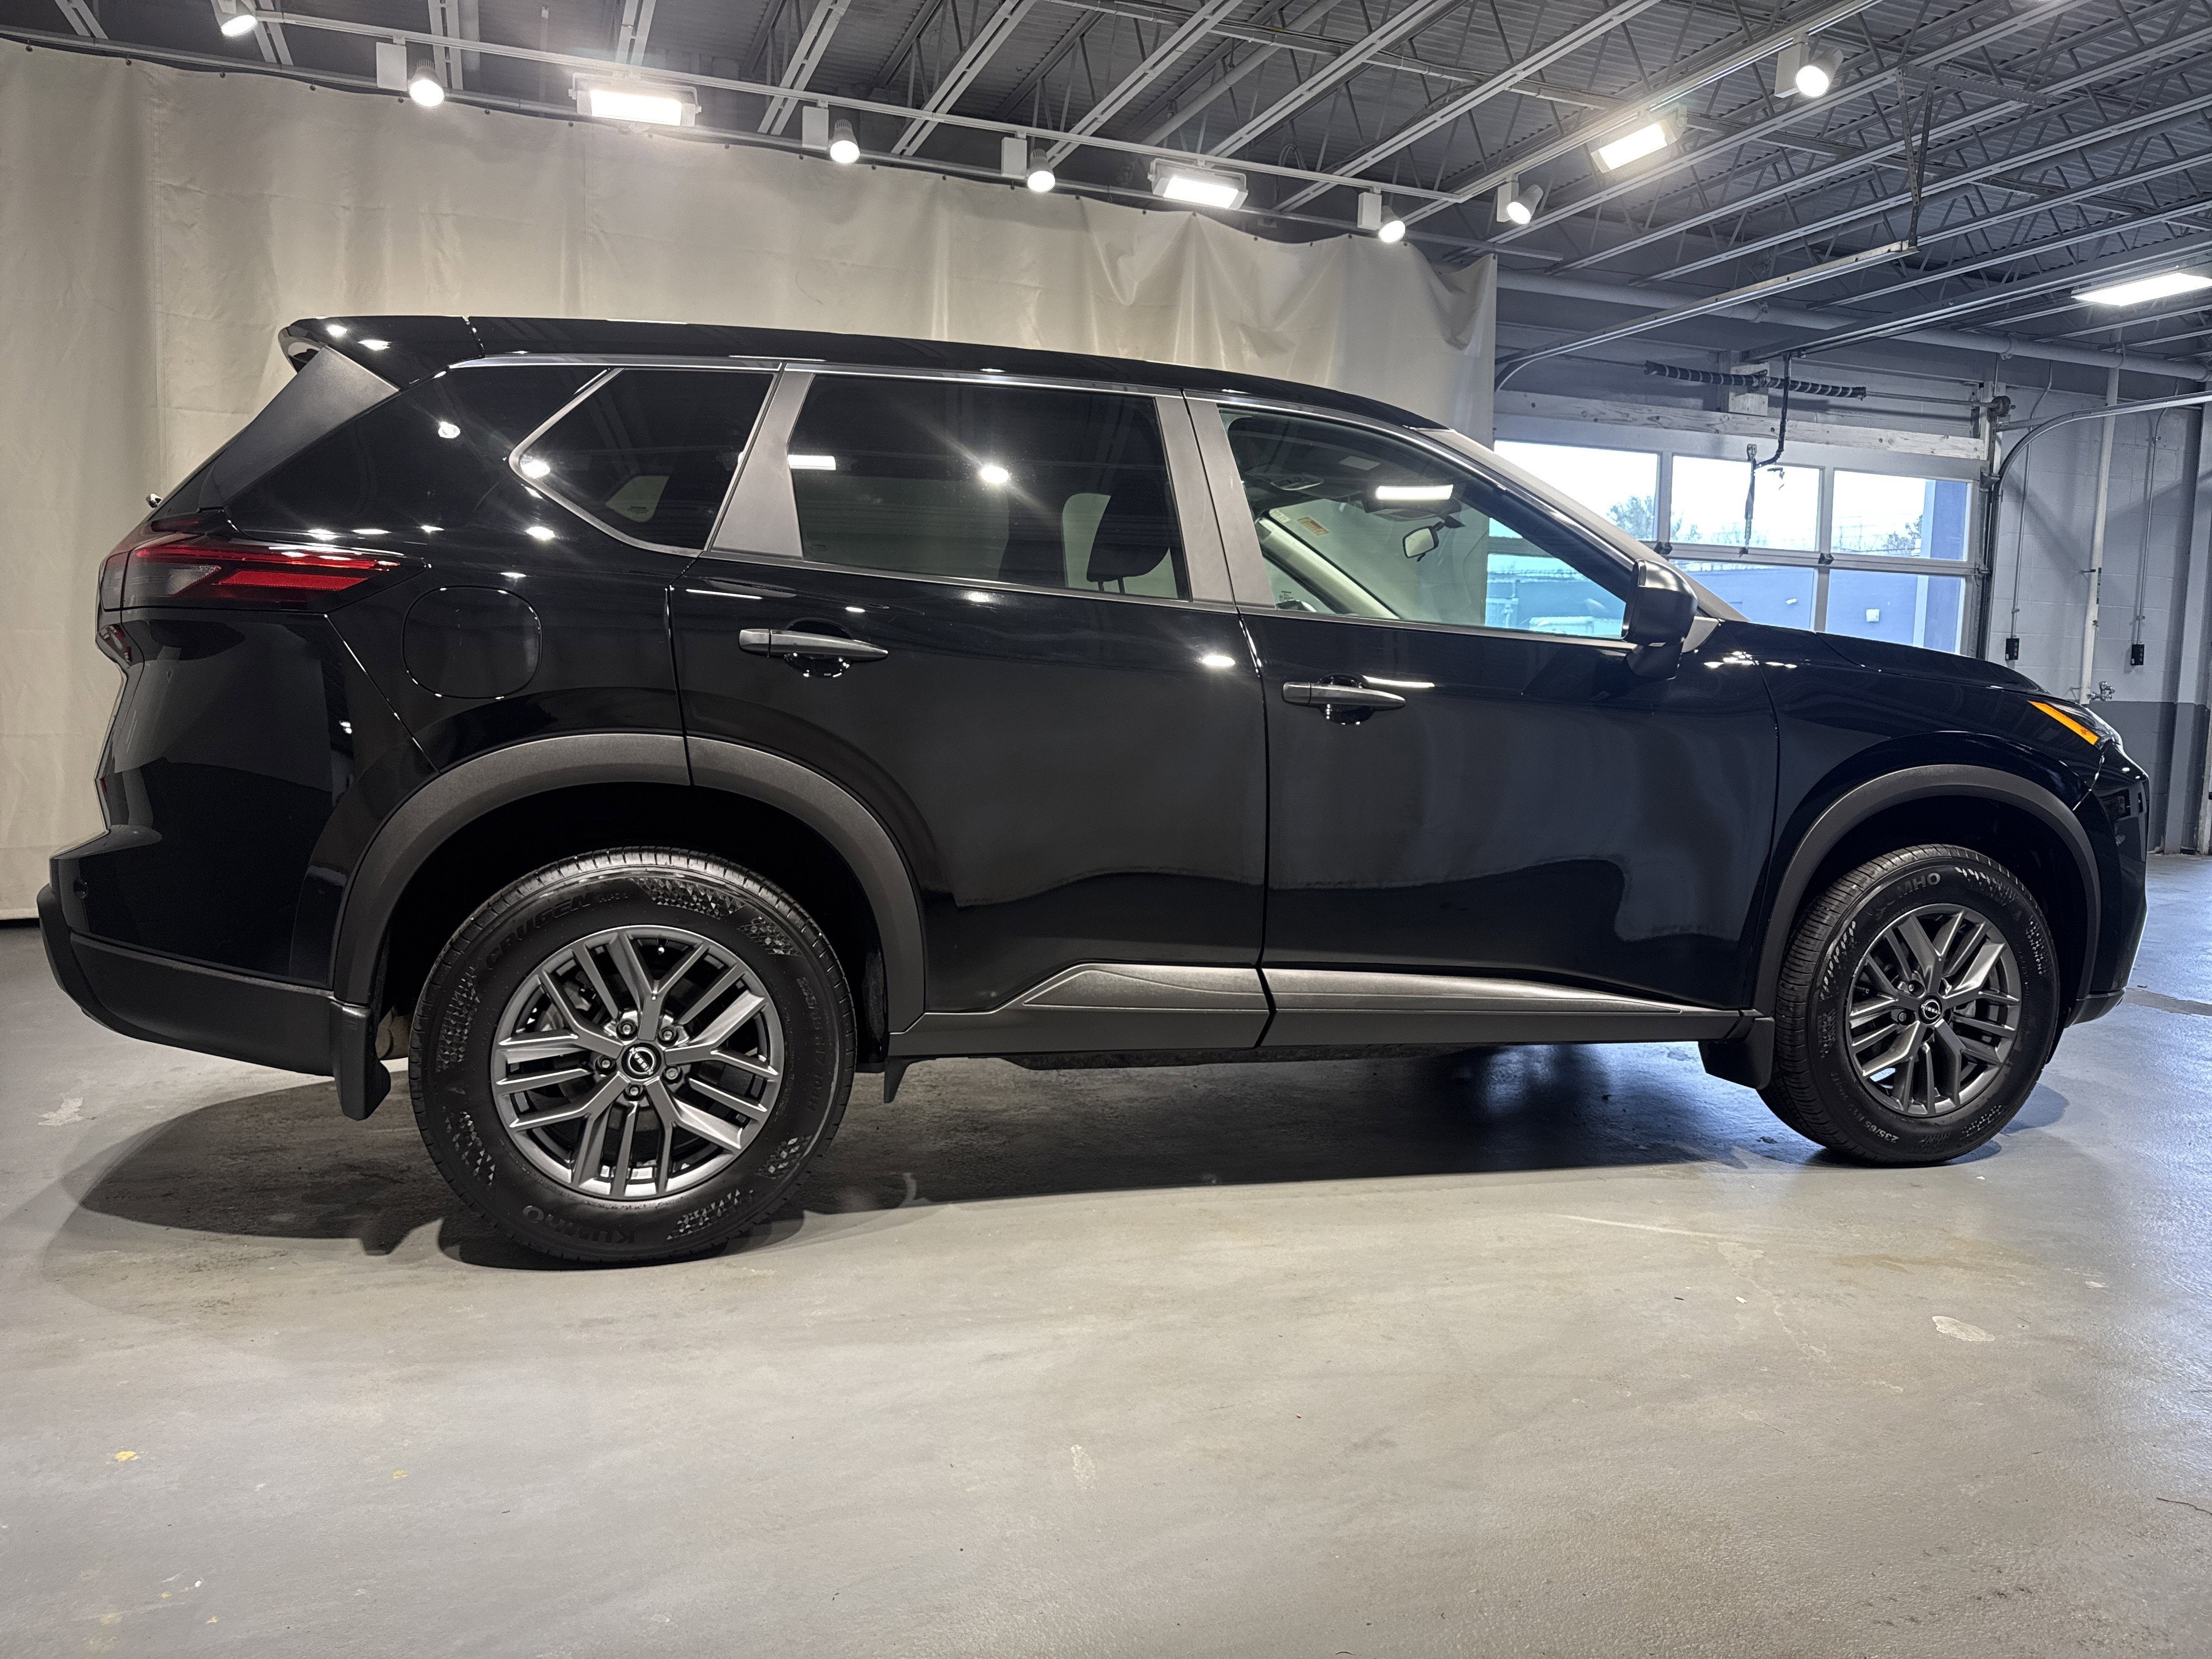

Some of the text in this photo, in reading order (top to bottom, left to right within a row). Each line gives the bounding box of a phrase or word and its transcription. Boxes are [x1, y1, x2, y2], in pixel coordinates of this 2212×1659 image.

[1921, 1003, 1942, 1016] NISSAN
[629, 1046, 654, 1075] NISSAN
[1863, 1120, 1900, 1144] 235/65
